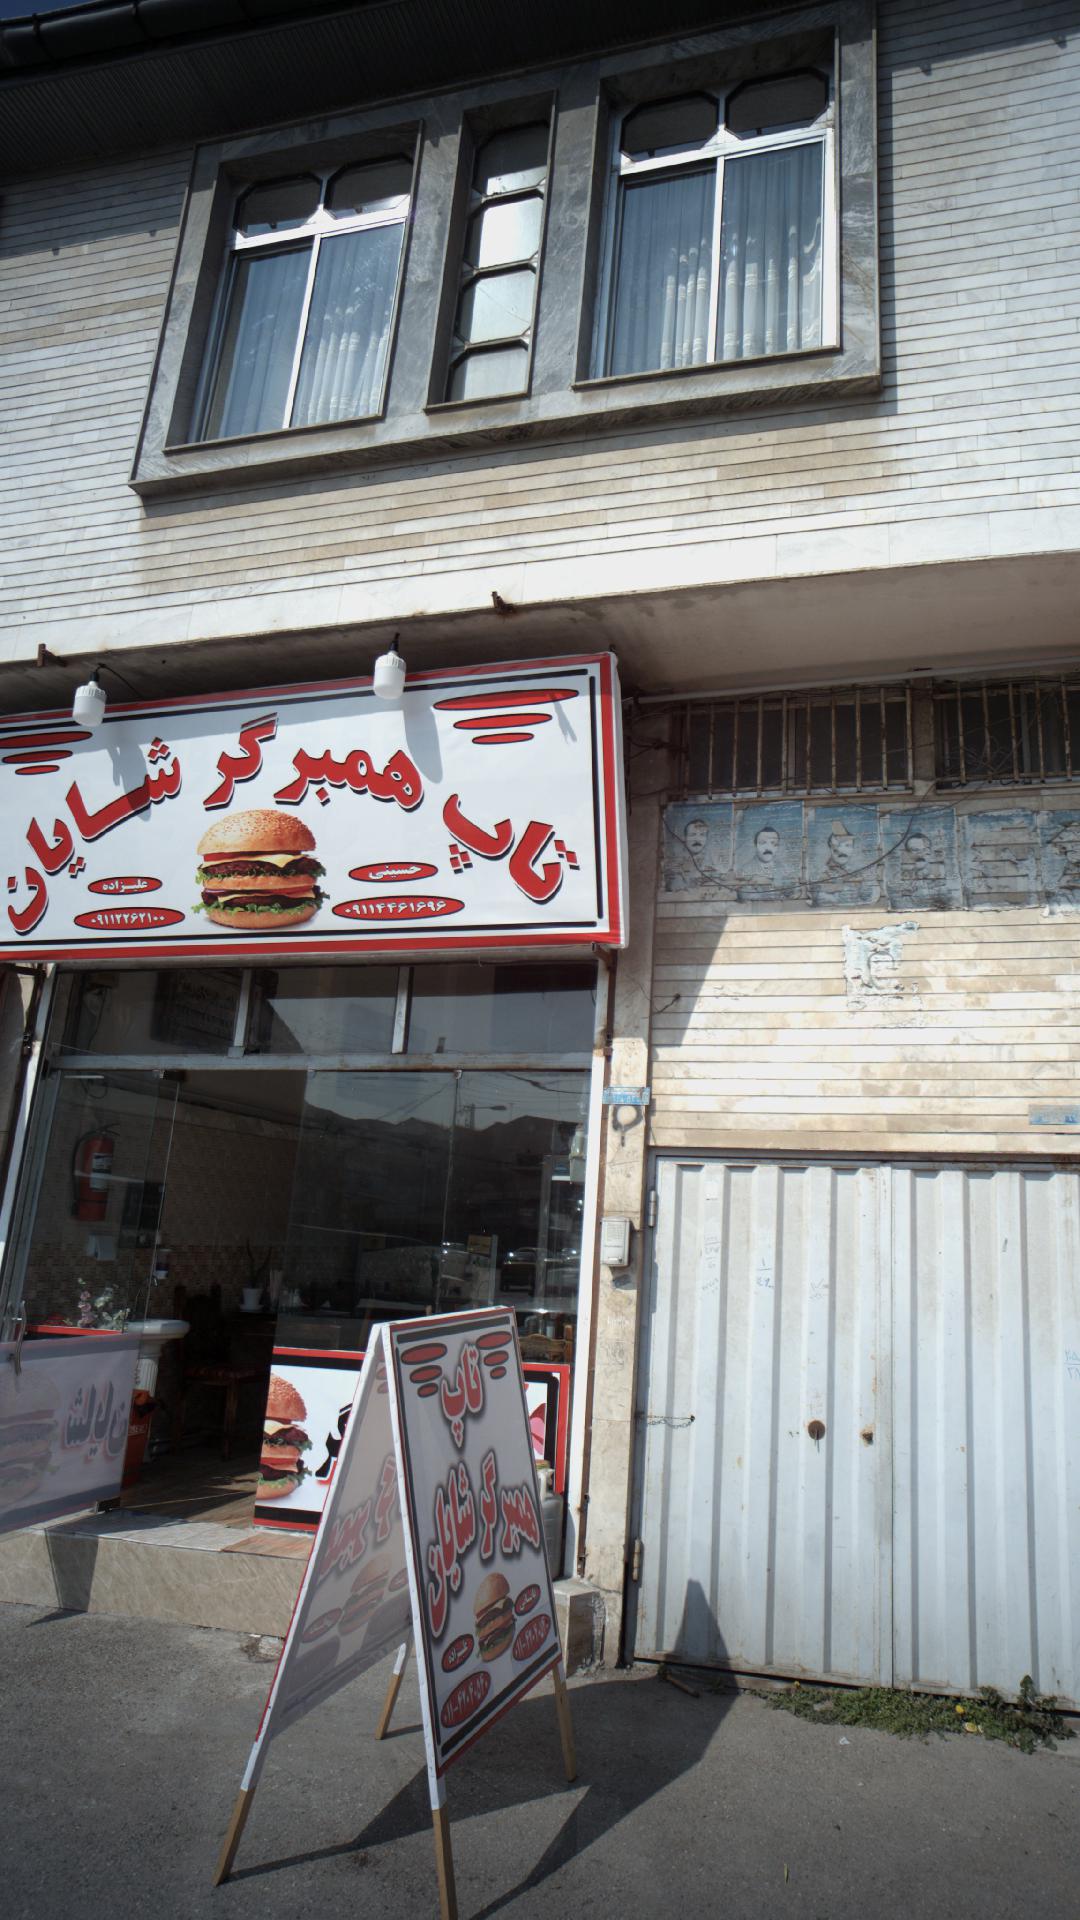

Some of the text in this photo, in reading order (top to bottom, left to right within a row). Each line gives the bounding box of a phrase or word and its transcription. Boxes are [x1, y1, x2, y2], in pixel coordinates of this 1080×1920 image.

[6, 737, 183, 935] شایان
[368, 864, 422, 880] حسینی
[442, 793, 581, 902] تاپ
[441, 1340, 483, 1447] تاپ
[428, 1464, 475, 1637] شایان
